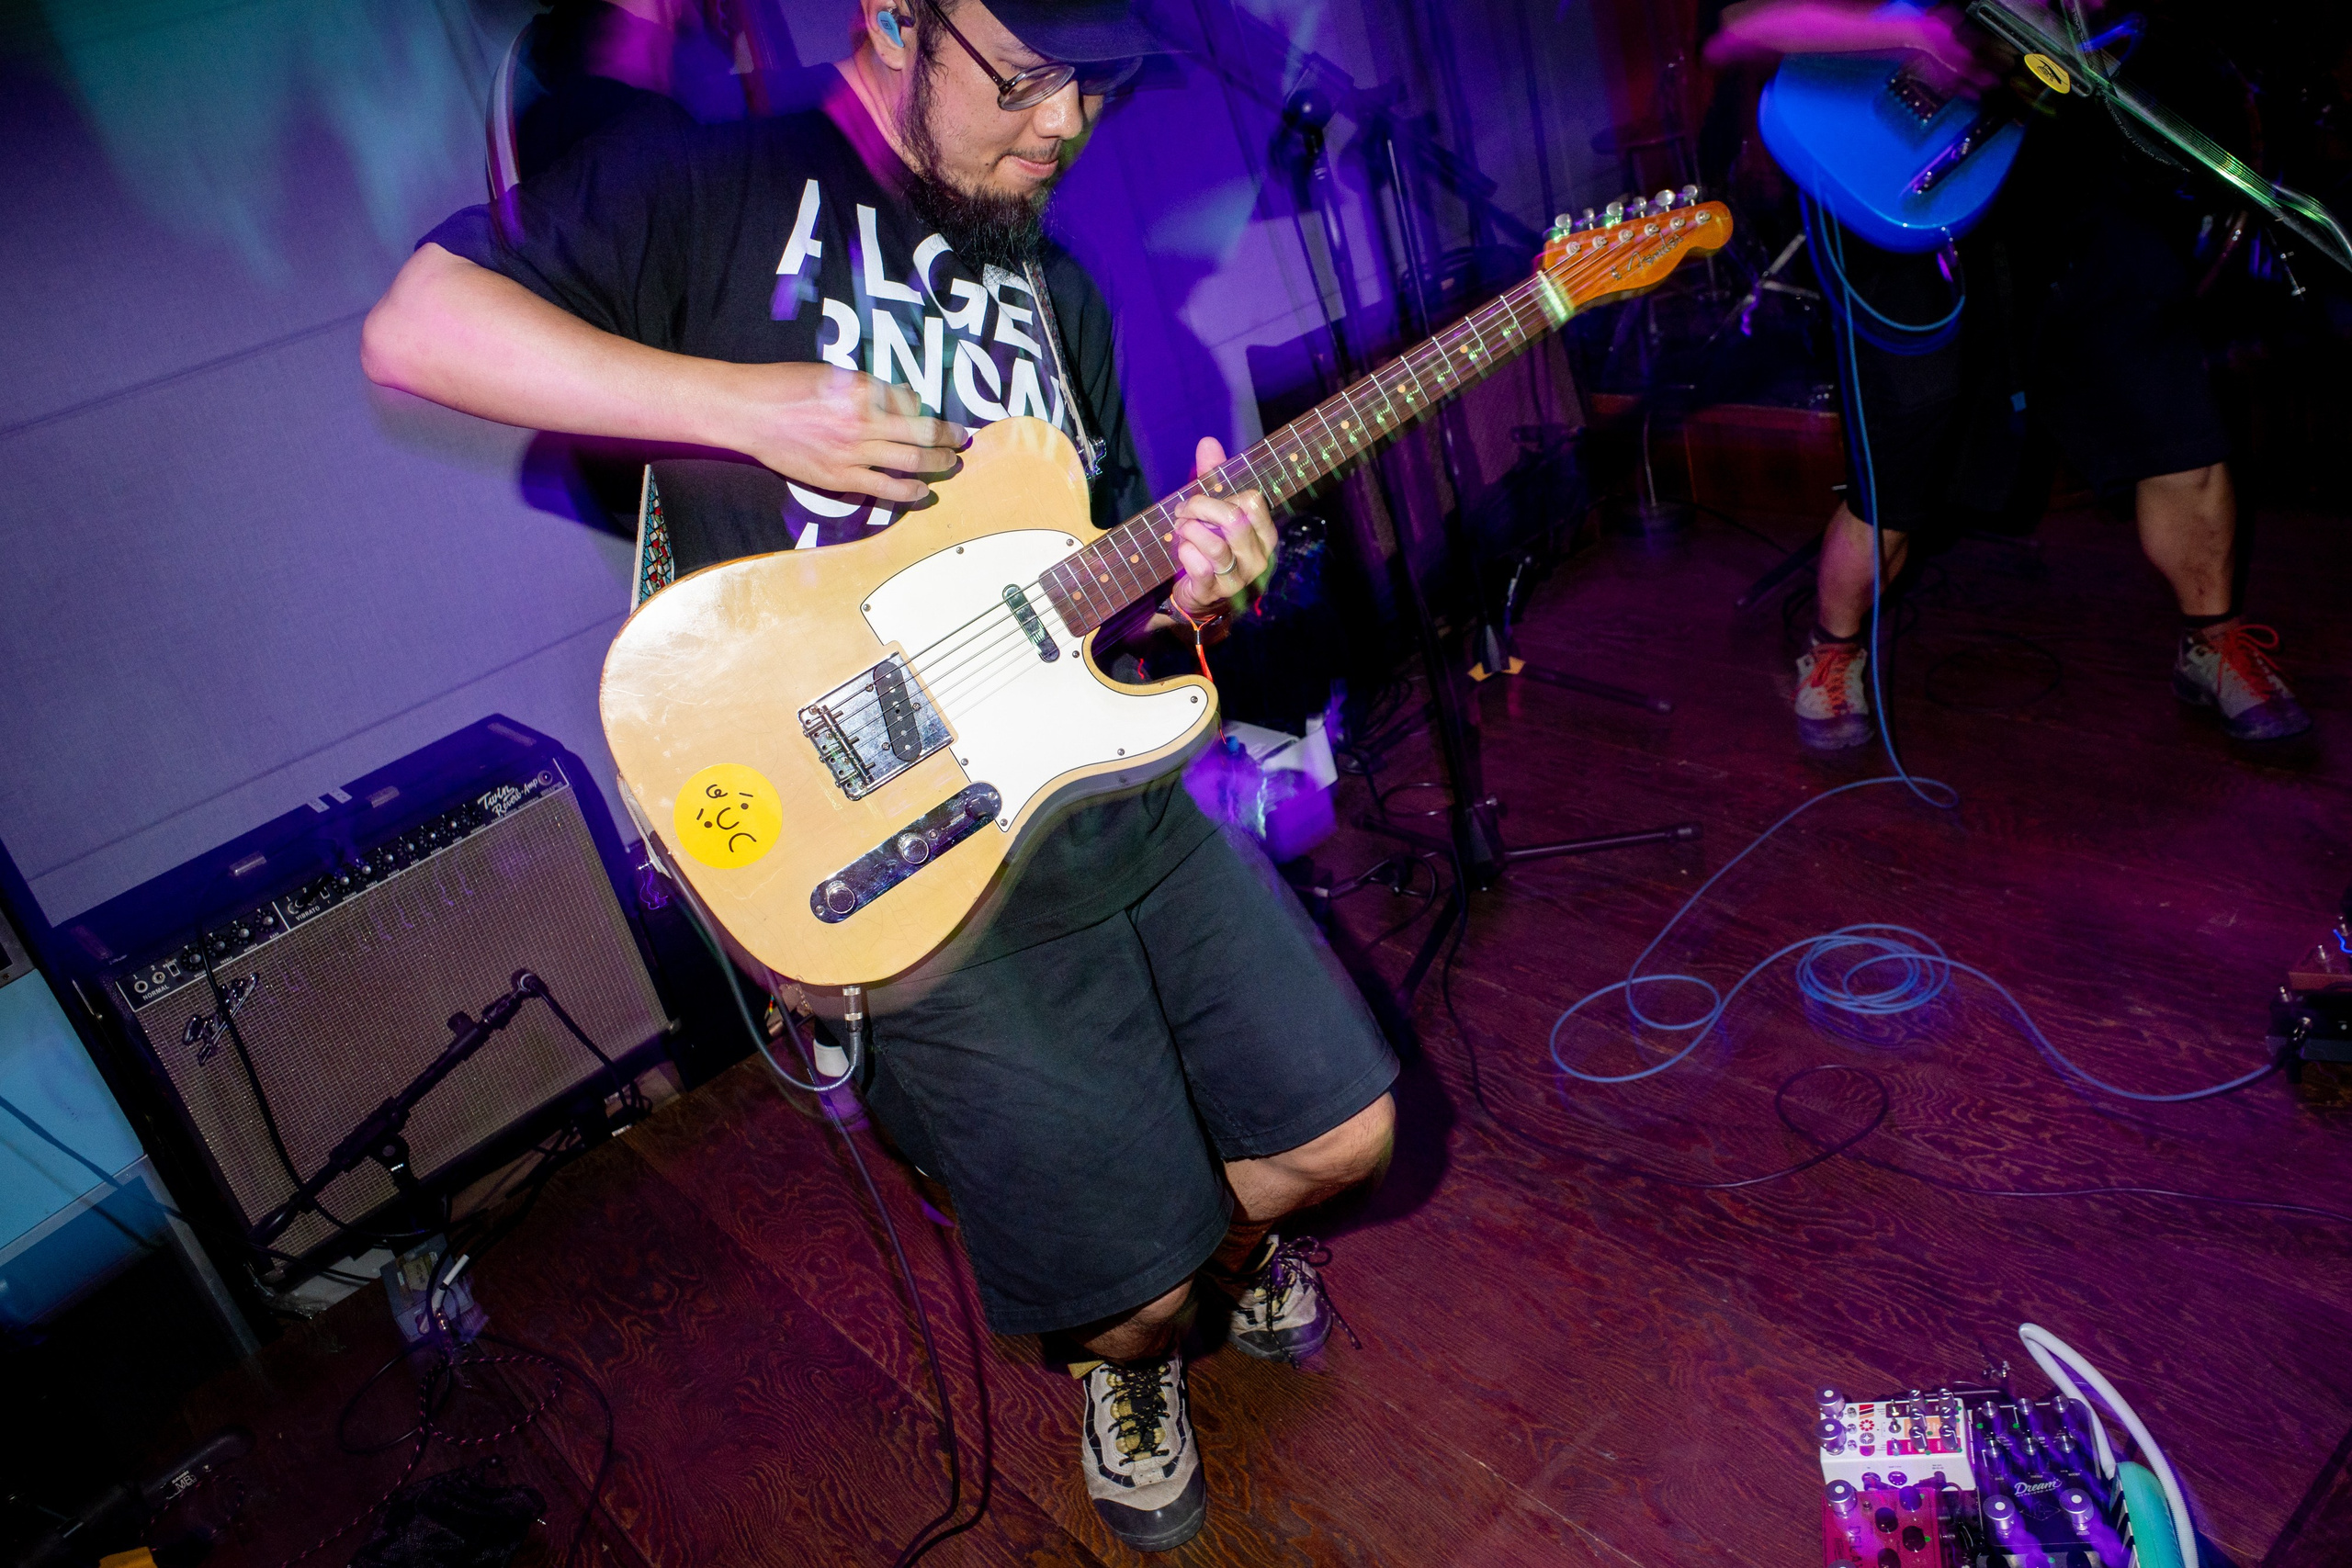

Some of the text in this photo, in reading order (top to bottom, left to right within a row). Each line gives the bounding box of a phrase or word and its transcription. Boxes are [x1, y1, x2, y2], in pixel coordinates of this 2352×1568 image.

[477, 785, 514, 809] Twin
[296, 905, 321, 921] VIBRATO
[142, 985, 170, 1001] NORMAL
[2014, 1478, 2063, 1495] Dream
